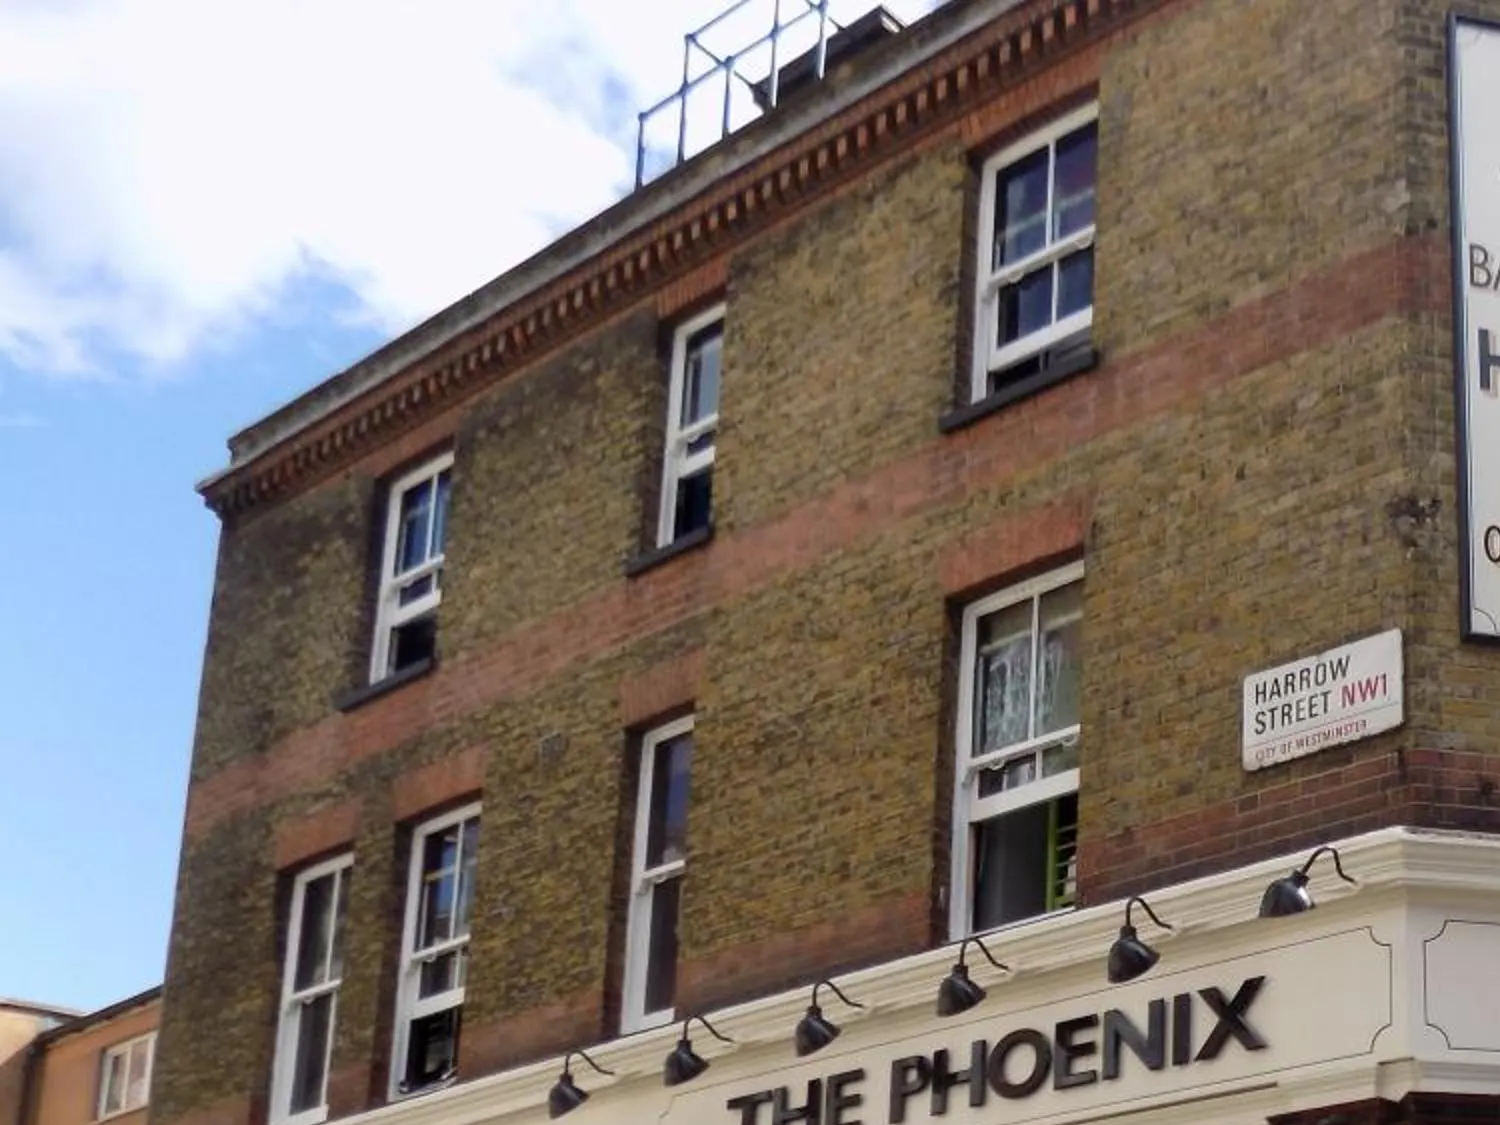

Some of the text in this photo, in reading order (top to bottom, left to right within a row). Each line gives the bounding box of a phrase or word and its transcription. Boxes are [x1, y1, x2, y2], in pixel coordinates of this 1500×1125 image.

[1254, 655, 1351, 706] HARROW
[1254, 672, 1388, 735] STREET NW1
[1255, 719, 1367, 761] CITY OF WESTMINSTER
[888, 975, 1270, 1125] PHOENIX
